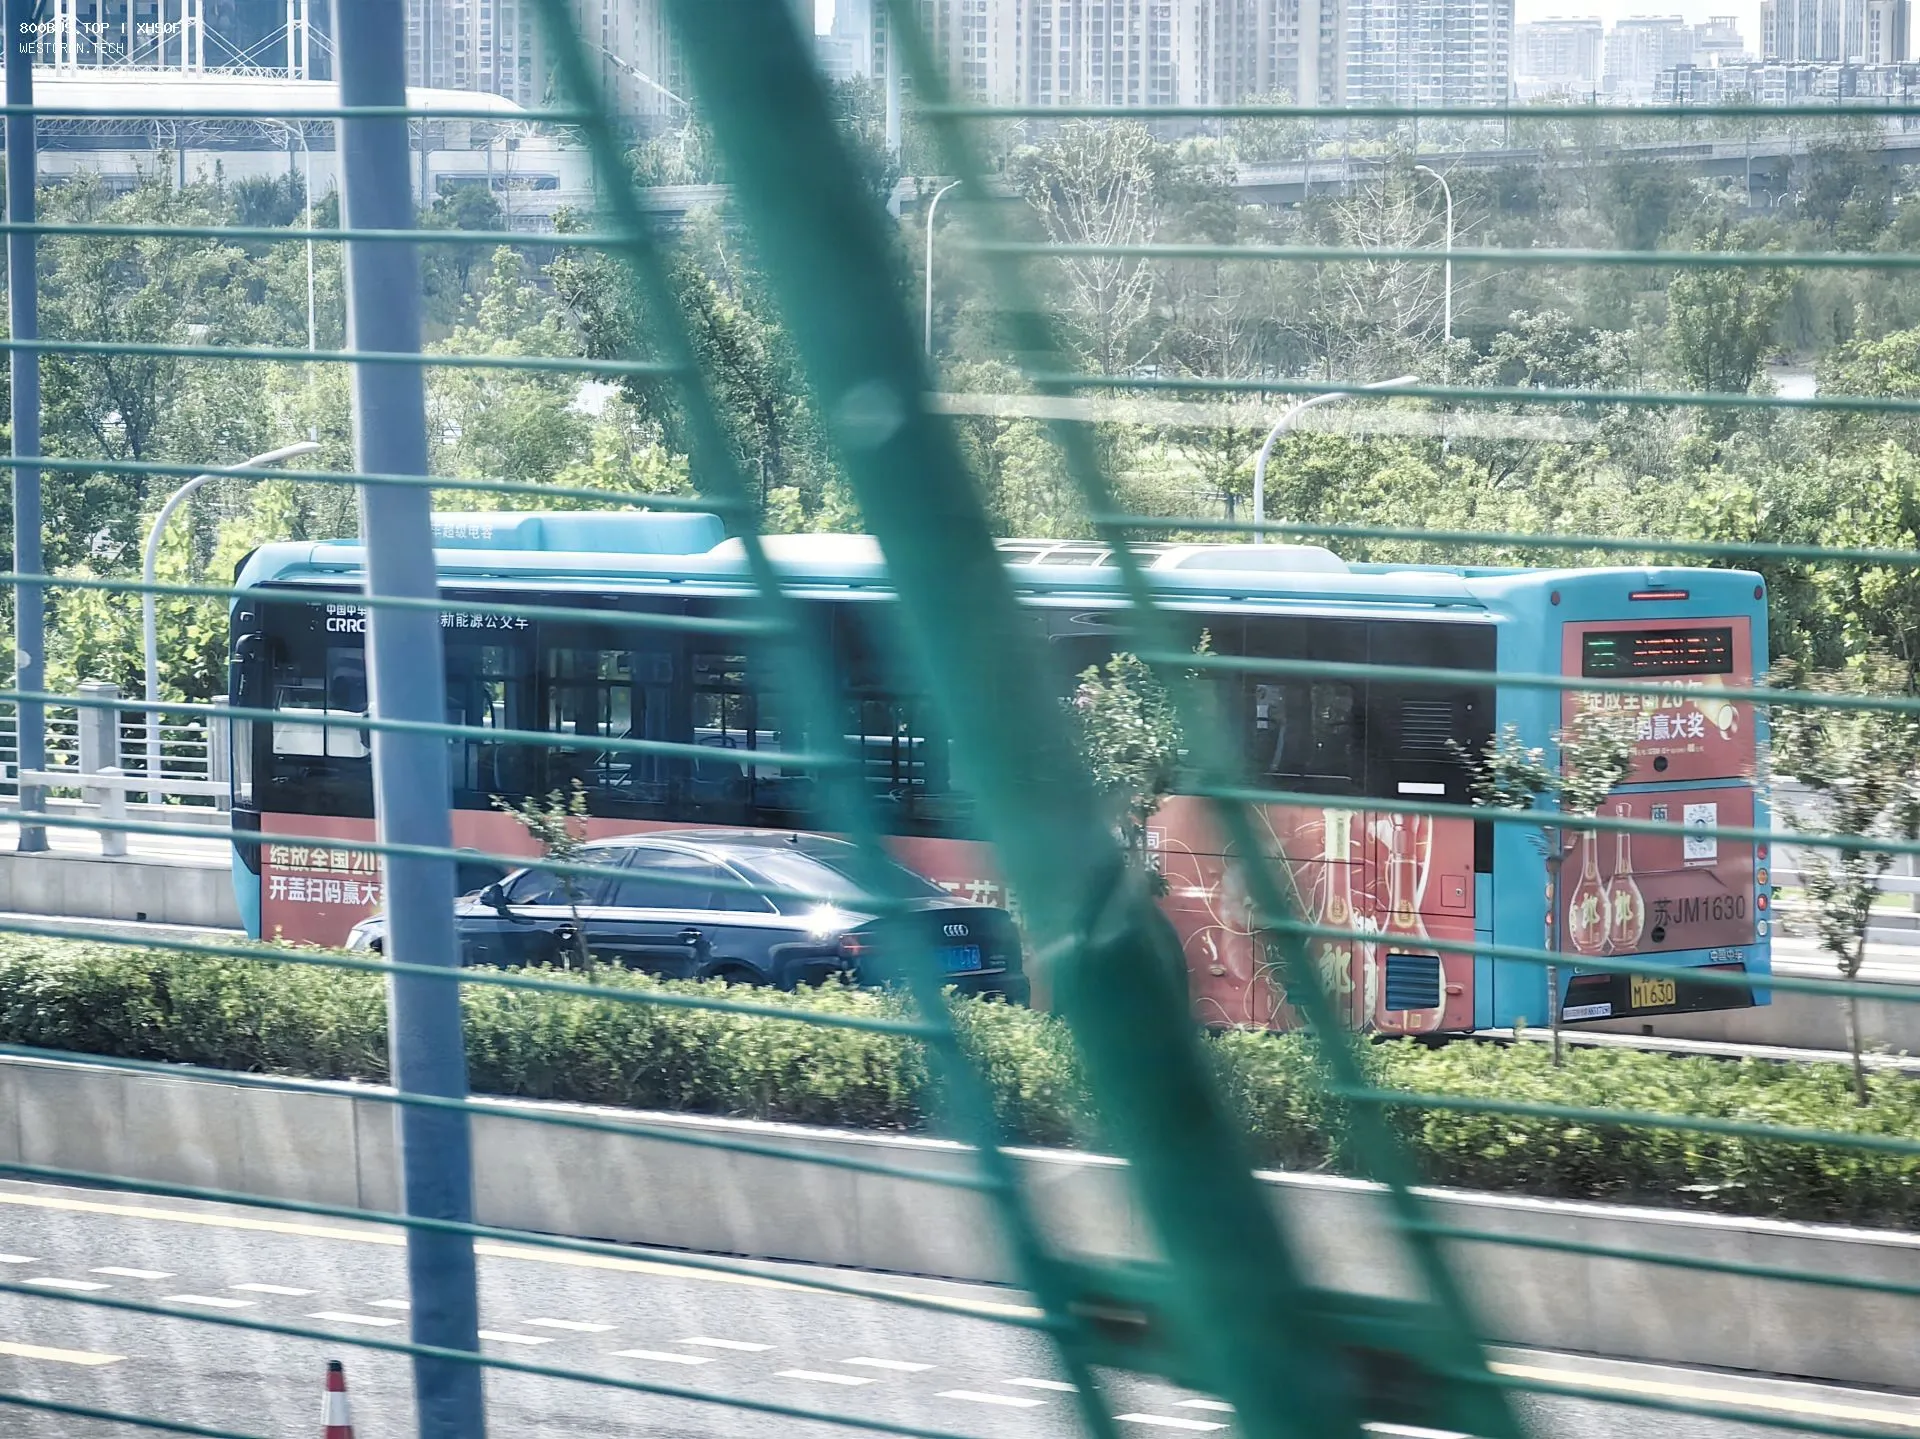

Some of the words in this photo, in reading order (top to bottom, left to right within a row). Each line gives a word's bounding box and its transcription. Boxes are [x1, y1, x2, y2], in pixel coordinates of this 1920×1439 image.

[326, 617, 367, 633] CRRC
[269, 844, 384, 875] 绽放全国20
[269, 875, 384, 906] 开盖扫码赢大
[1654, 896, 1746, 927] 苏JM1630
[1633, 983, 1674, 1007] M1630
